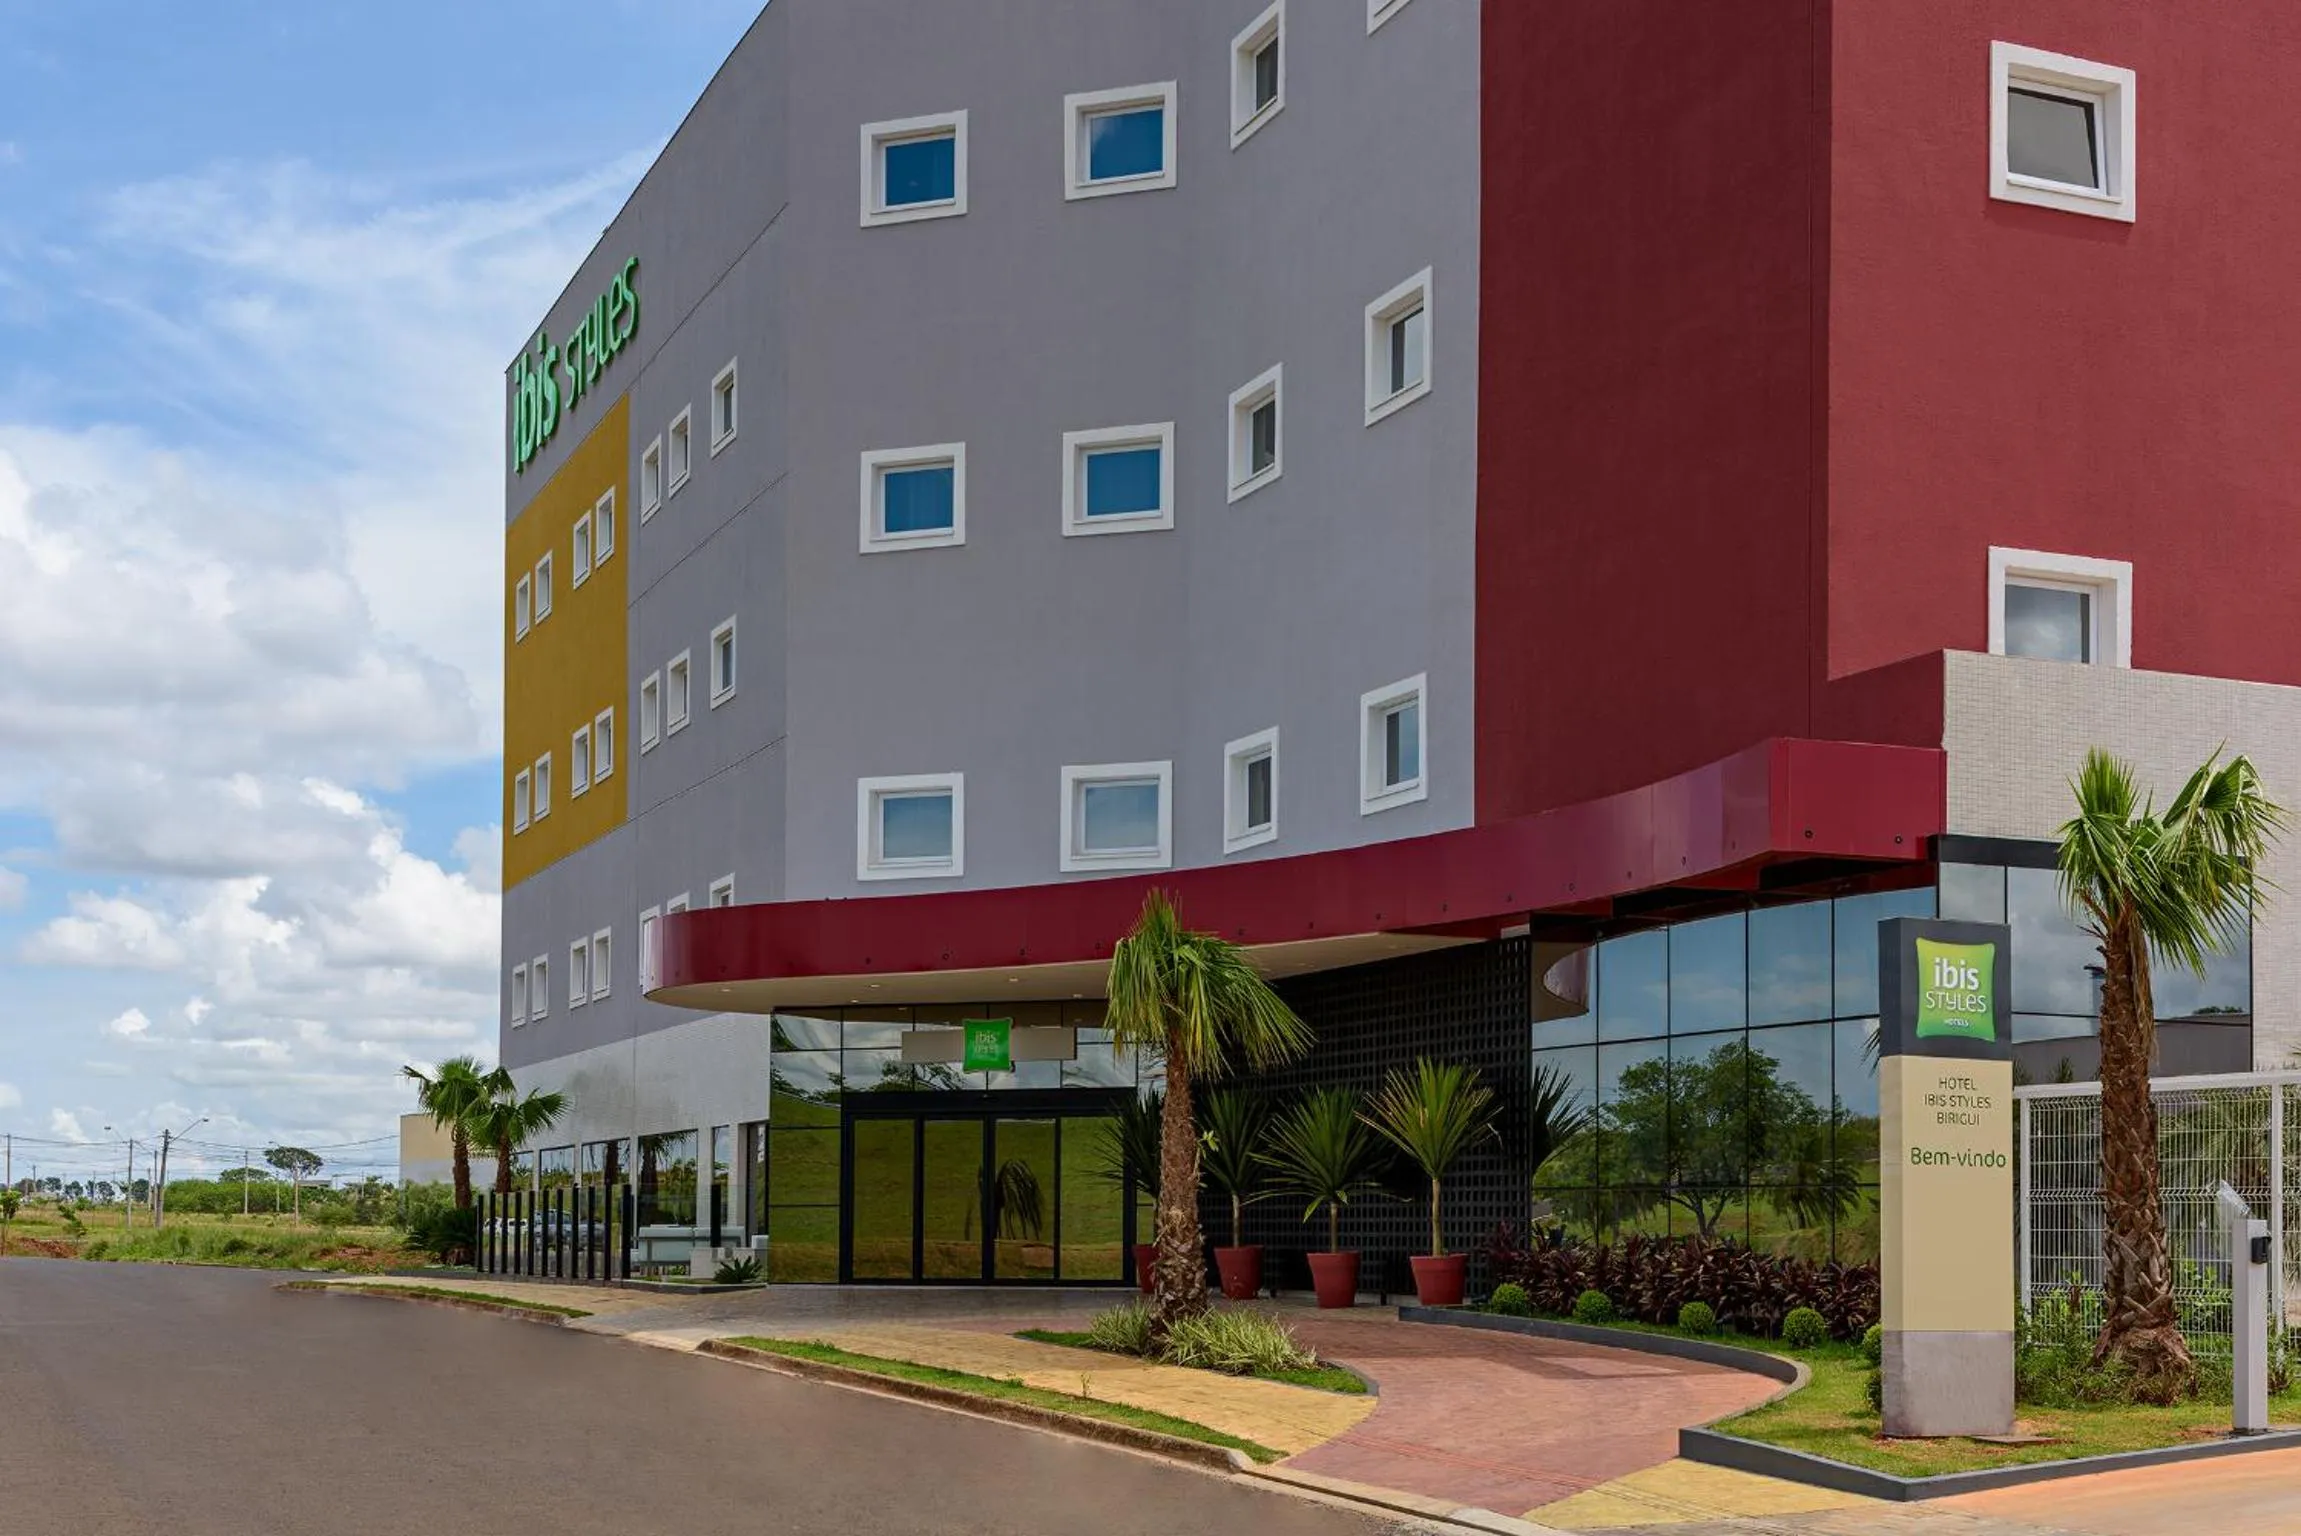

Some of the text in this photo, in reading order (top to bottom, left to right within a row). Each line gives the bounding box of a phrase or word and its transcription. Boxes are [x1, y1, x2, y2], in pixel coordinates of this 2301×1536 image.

[513, 331, 560, 474] ibis
[1934, 957, 1980, 991] ibis
[1938, 1077, 1978, 1091] HOTEL
[1923, 1093, 1992, 1109] IBIS STYLES
[1936, 1111, 1981, 1126] BIRIGUI
[1910, 1146, 2007, 1168] Bem-vindo
